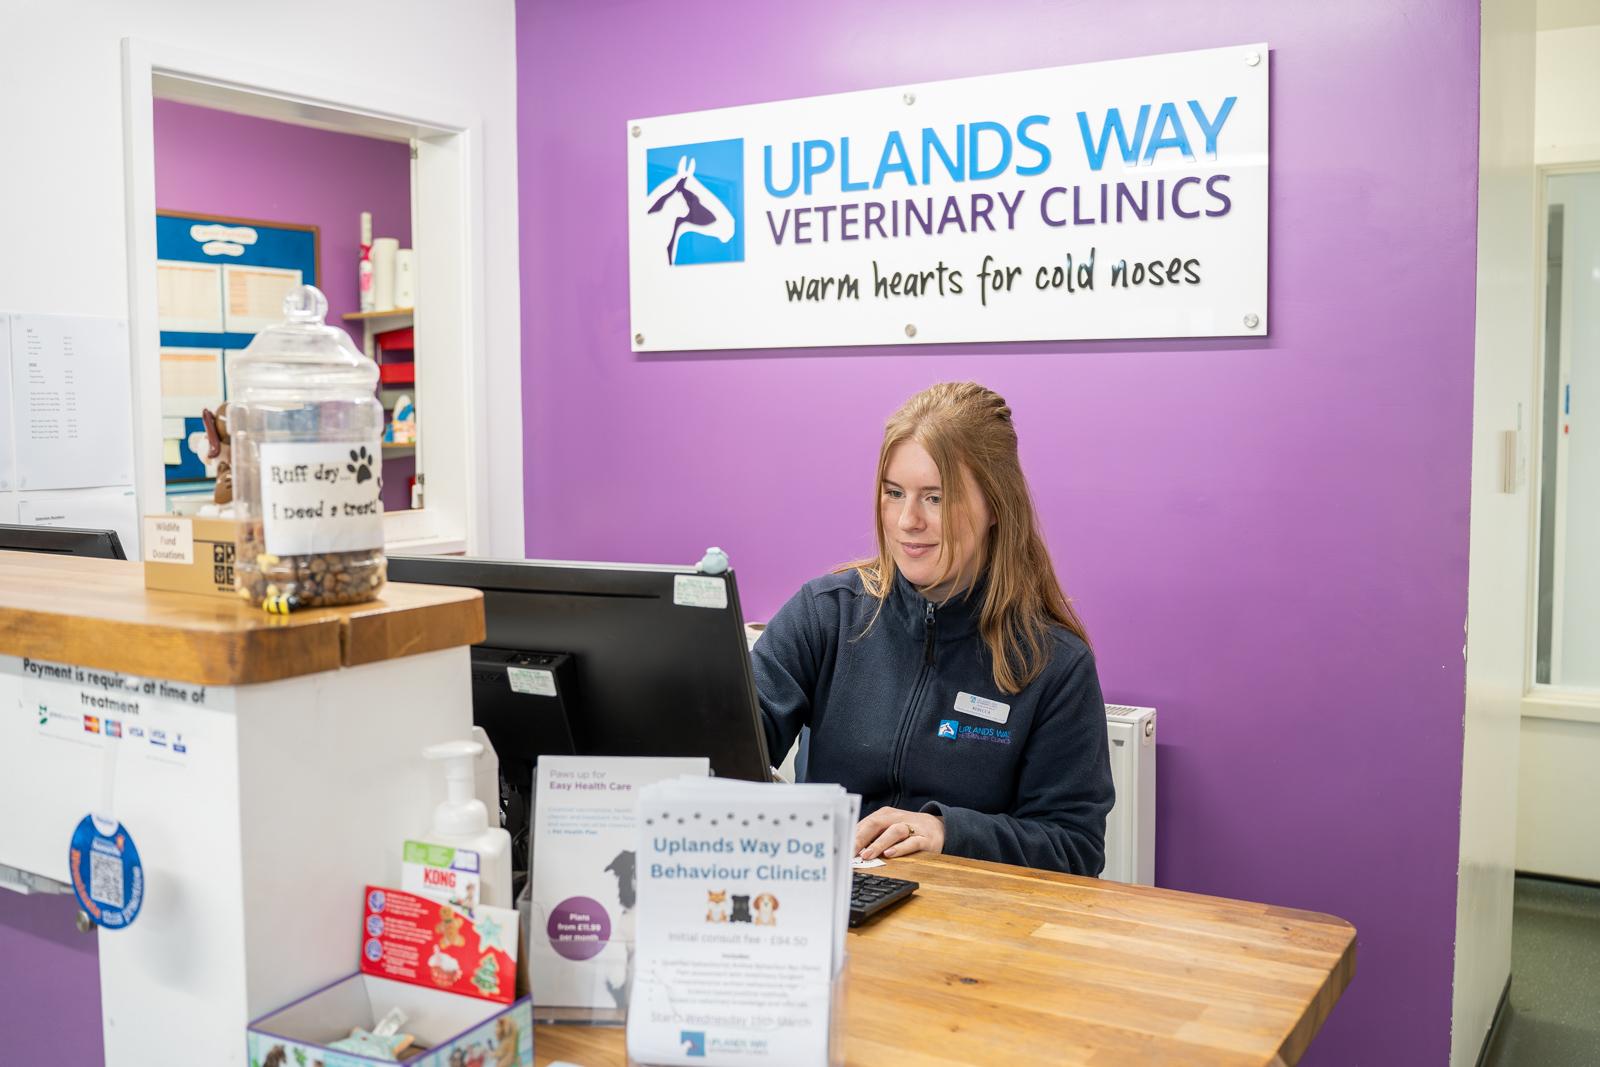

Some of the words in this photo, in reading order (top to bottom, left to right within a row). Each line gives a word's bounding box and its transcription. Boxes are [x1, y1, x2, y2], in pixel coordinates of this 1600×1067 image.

[763, 114, 1051, 198] UPLANDS
[1076, 96, 1238, 171] WAY
[765, 189, 1026, 246] VETERINARY
[1039, 174, 1233, 228] CLINICS
[785, 271, 860, 302] warm
[872, 260, 963, 300] hearts
[978, 255, 1023, 306] for
[1035, 247, 1097, 293] cold
[1110, 255, 1202, 289] noses
[271, 465, 308, 484] Ruff
[284, 501, 324, 519] need
[155, 521, 181, 532] Wildlife
[160, 536, 176, 545] Fund
[152, 550, 186, 561] Donations
[23, 658, 73, 679] Payment
[75, 666, 84, 682] is
[87, 673, 139, 691] requir
[143, 681, 156, 694] at
[160, 682, 187, 701] time
[191, 687, 206, 703] of
[81, 692, 140, 714] treatment
[550, 769, 575, 778] Paws
[577, 771, 590, 780] up
[592, 770, 607, 778] for
[549, 781, 572, 791] Easy
[575, 781, 607, 790] Health
[609, 782, 632, 791] Care
[653, 837, 734, 854] Uplands
[739, 839, 781, 857] Way
[787, 839, 825, 858] Dog
[424, 867, 456, 888] KONG
[650, 863, 749, 880] Behaviour
[756, 865, 828, 881] Clinics!
